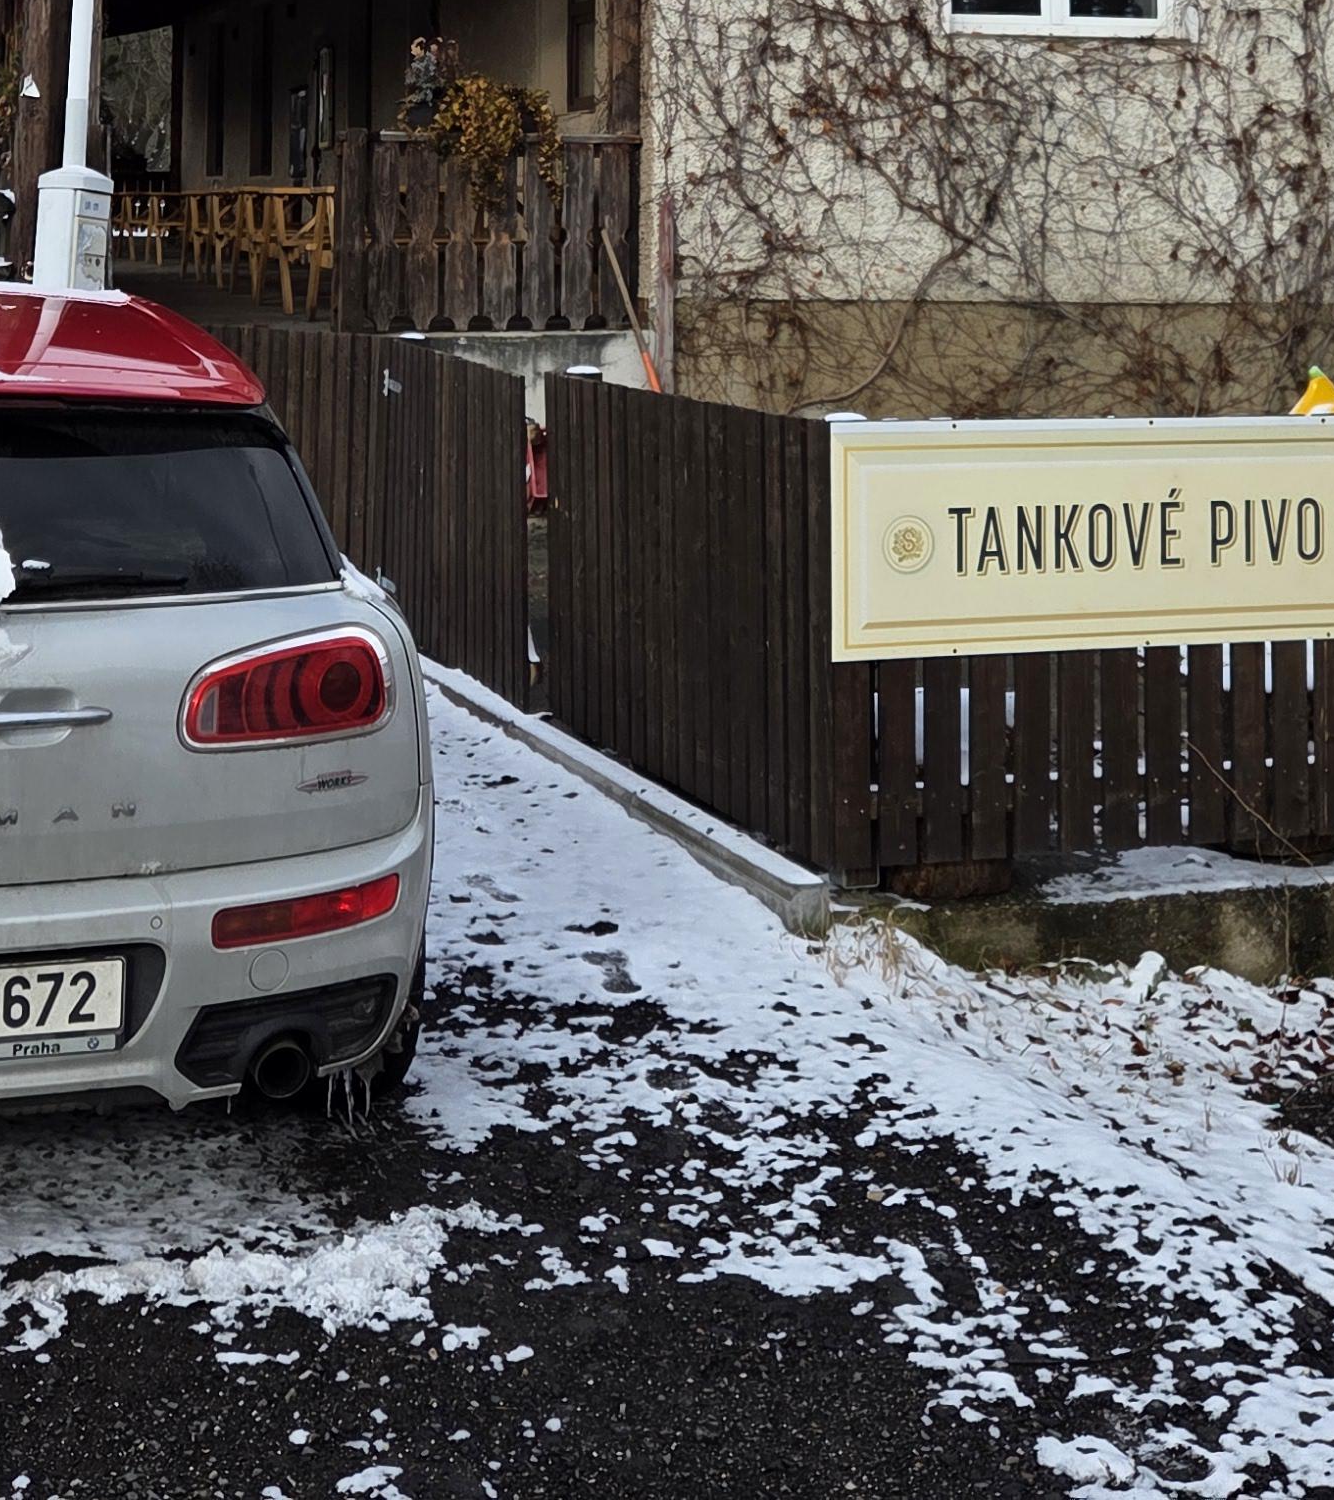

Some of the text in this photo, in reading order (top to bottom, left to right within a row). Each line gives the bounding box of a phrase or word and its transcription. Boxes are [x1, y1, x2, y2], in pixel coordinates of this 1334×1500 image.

[947, 488, 1324, 574] TANKOVÉ PIVO
[13, 1042, 61, 1057] Praha
